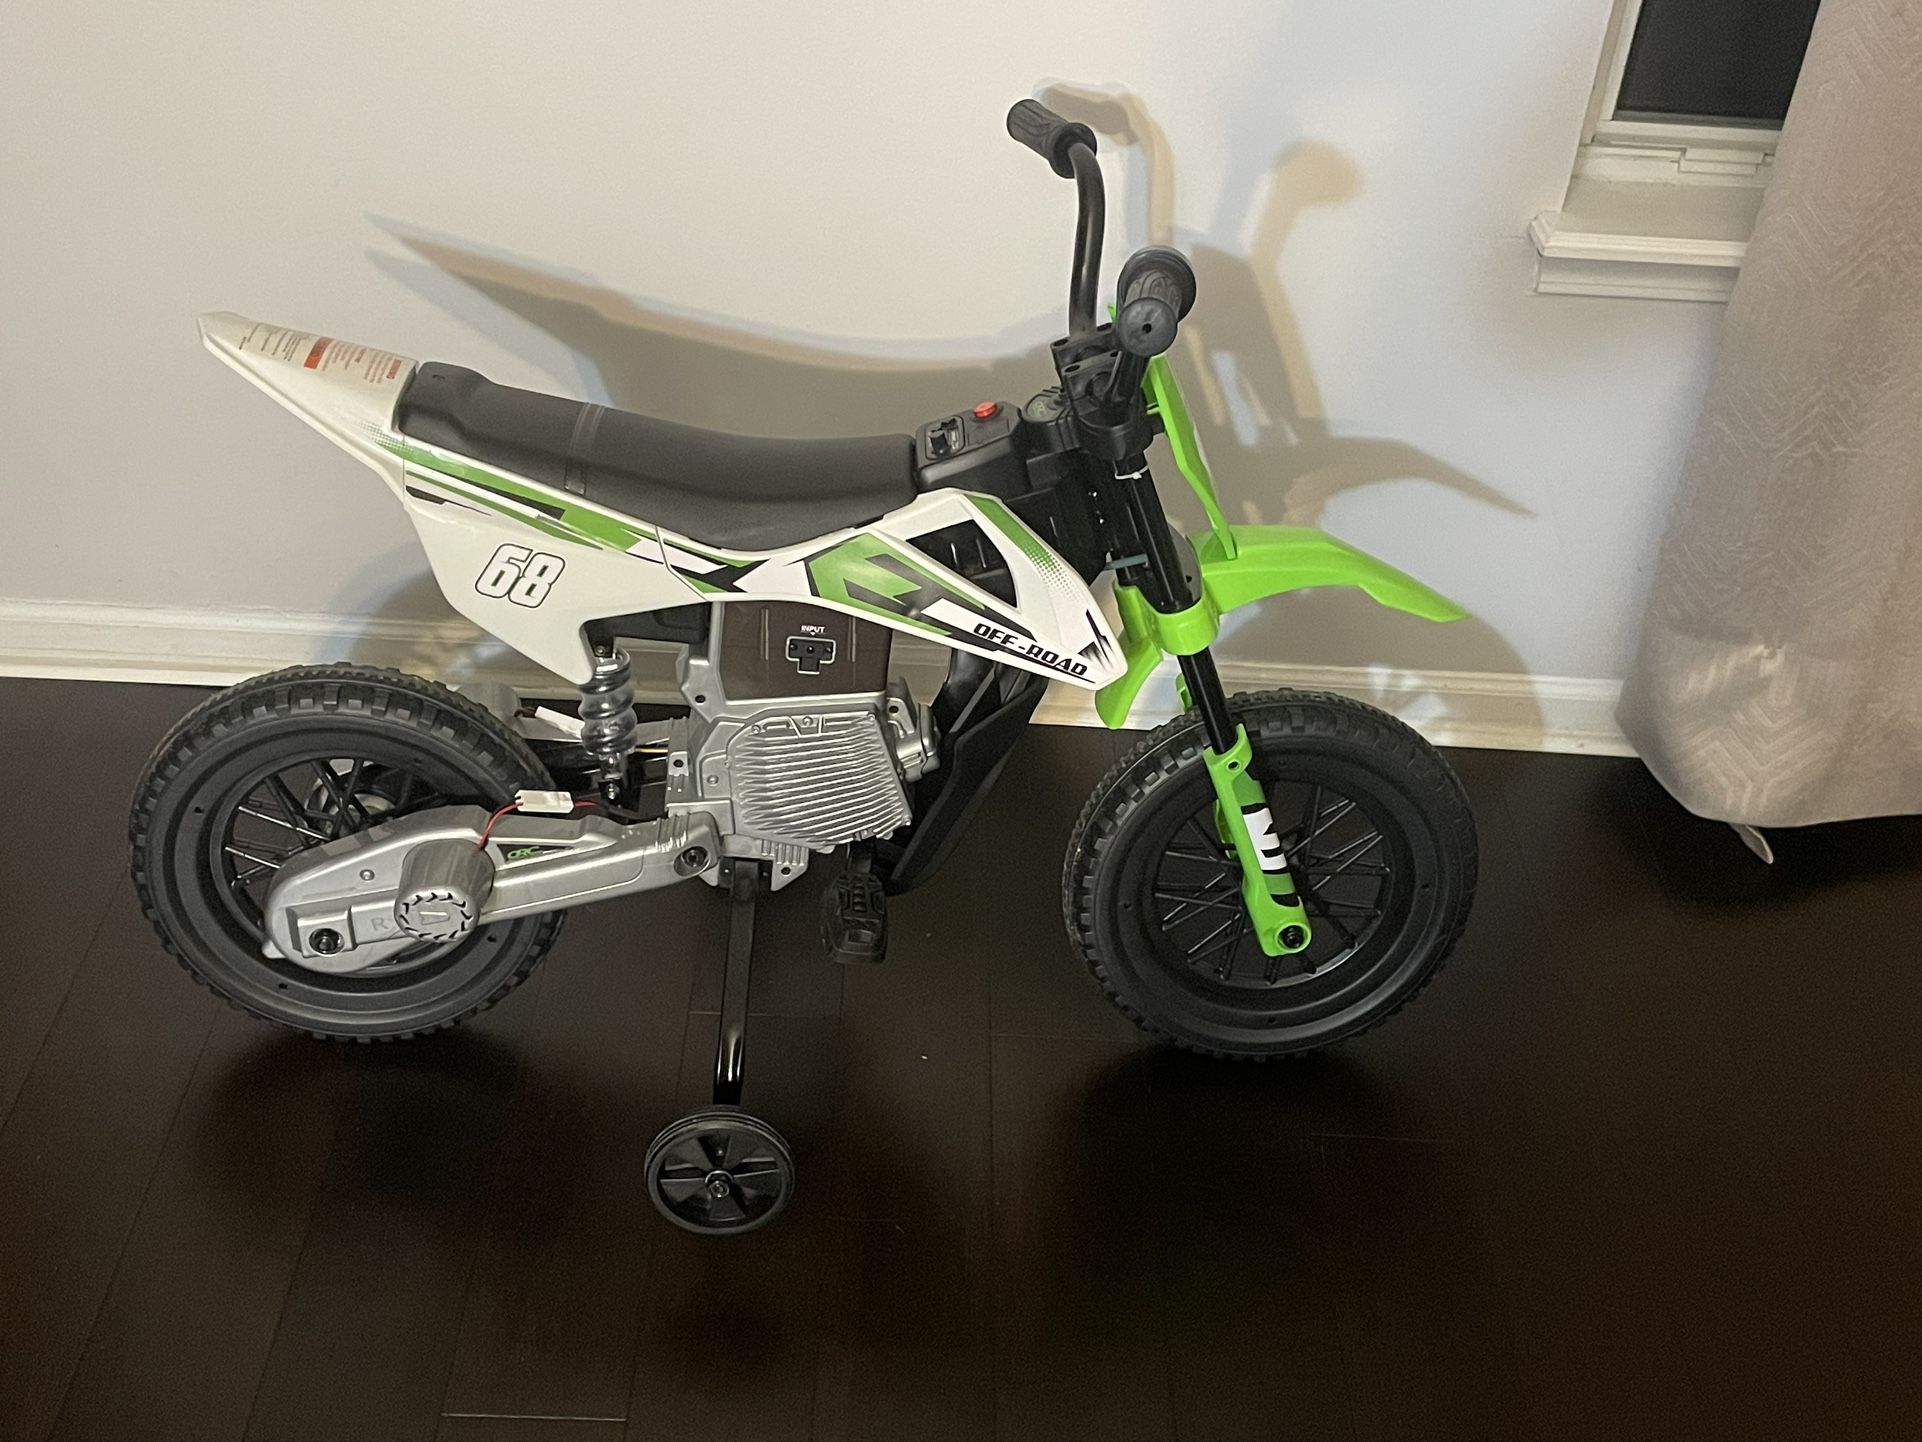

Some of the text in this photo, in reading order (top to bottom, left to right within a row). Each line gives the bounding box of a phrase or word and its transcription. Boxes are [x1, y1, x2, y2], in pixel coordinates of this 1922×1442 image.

[475, 543, 566, 609] 68
[801, 625, 825, 634] INPUT
[973, 623, 1088, 677] OFF-ROAD
[371, 917, 389, 931] R
